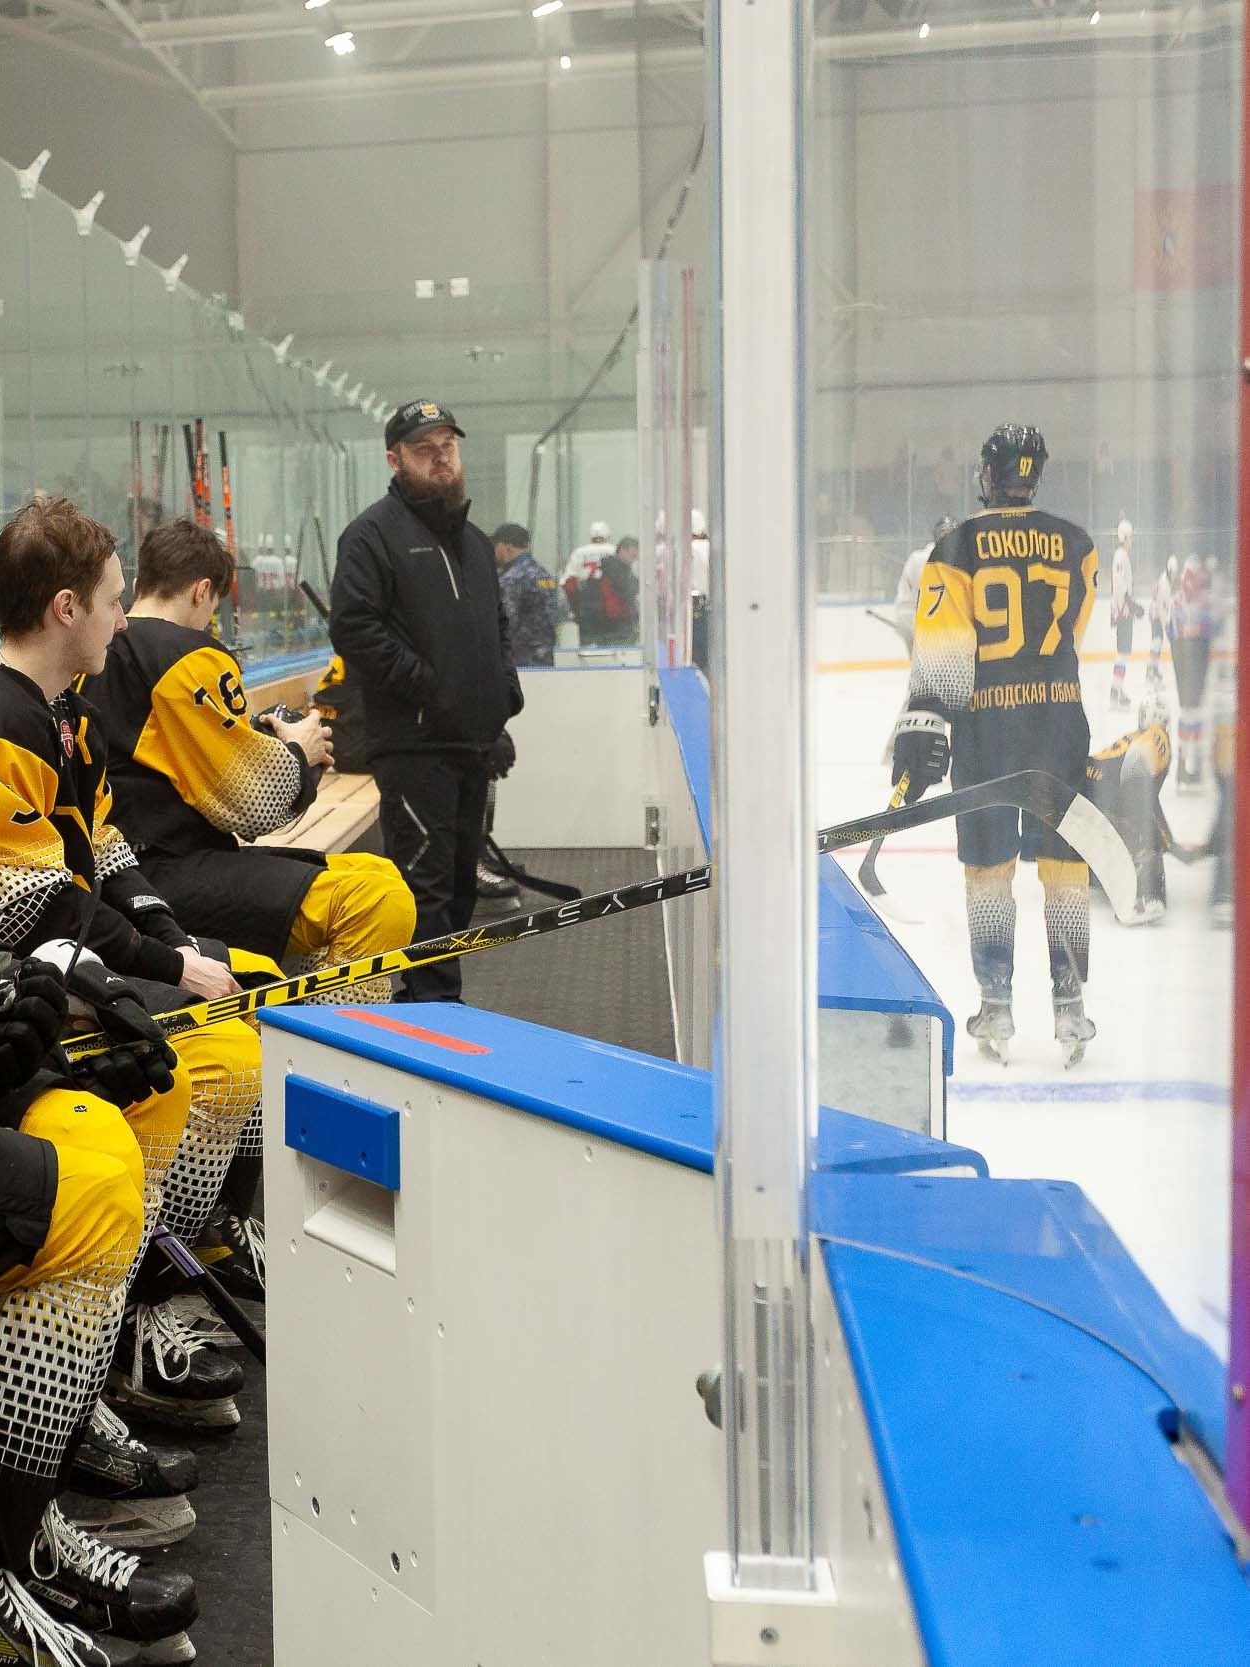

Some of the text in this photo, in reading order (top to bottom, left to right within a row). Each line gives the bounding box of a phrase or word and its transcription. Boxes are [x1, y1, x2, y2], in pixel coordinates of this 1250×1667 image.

[1019, 456, 1033, 477] 97
[976, 529, 1064, 562] СОКОЛОВ
[972, 562, 1071, 662] 97
[970, 681, 1047, 711] ЛОГОДСКАЯ
[897, 718, 944, 730] RUE
[206, 956, 402, 1023] TRUE
